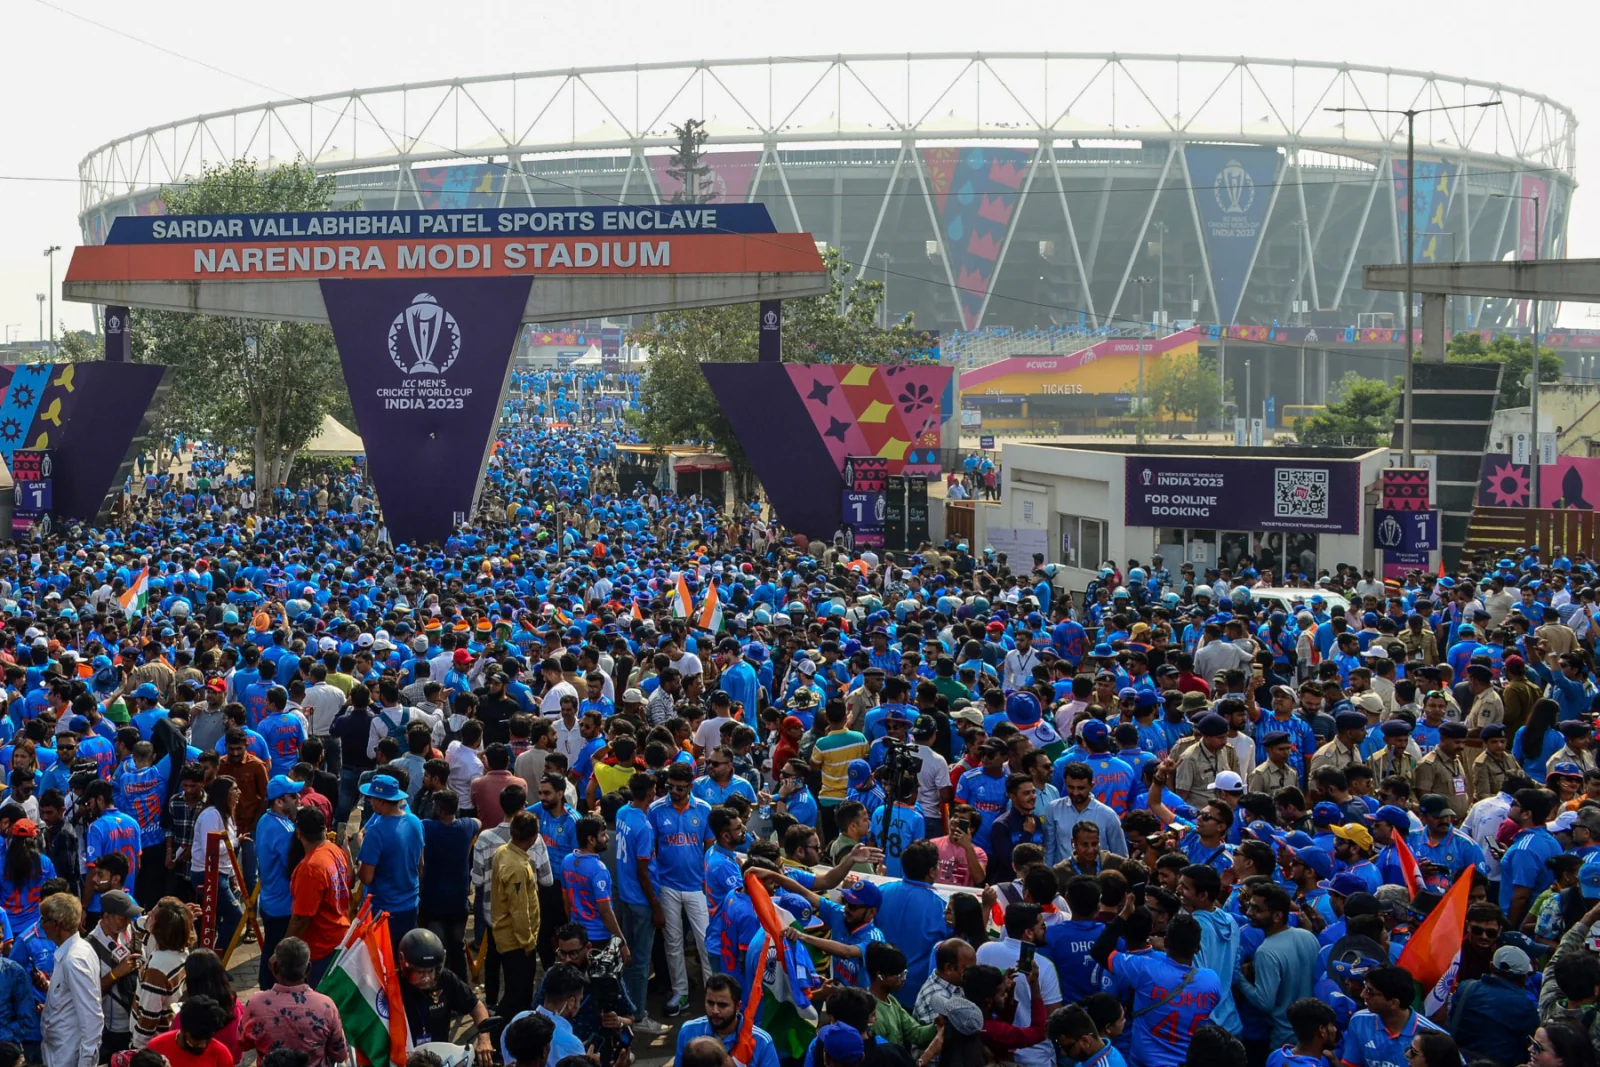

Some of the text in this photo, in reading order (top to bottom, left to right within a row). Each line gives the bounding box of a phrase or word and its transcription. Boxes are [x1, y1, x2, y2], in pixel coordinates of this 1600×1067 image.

[152, 210, 717, 238] SARDAR VALLABHBHAI PATEL SPORTS ENCLAVE
[1212, 229, 1255, 237] INDIA 2023
[194, 241, 670, 272] NARENDRA MODI STADIUM
[1026, 361, 1057, 369] #CWC23
[402, 379, 447, 388] ICC MEN'S
[376, 388, 473, 397] CRICKET WORLD CUP
[1042, 384, 1083, 395] TICKETS
[385, 398, 464, 410] INDIA 2023
[1157, 477, 1224, 487] INDIA 2023
[32, 490, 42, 508] 1
[1144, 494, 1217, 505] FOR ONLINE
[852, 502, 863, 522] 1
[1151, 506, 1210, 517] BOOKING
[1417, 522, 1426, 541] 1
[1415, 541, 1430, 549] (VIP)
[875, 815, 907, 830] VAT
